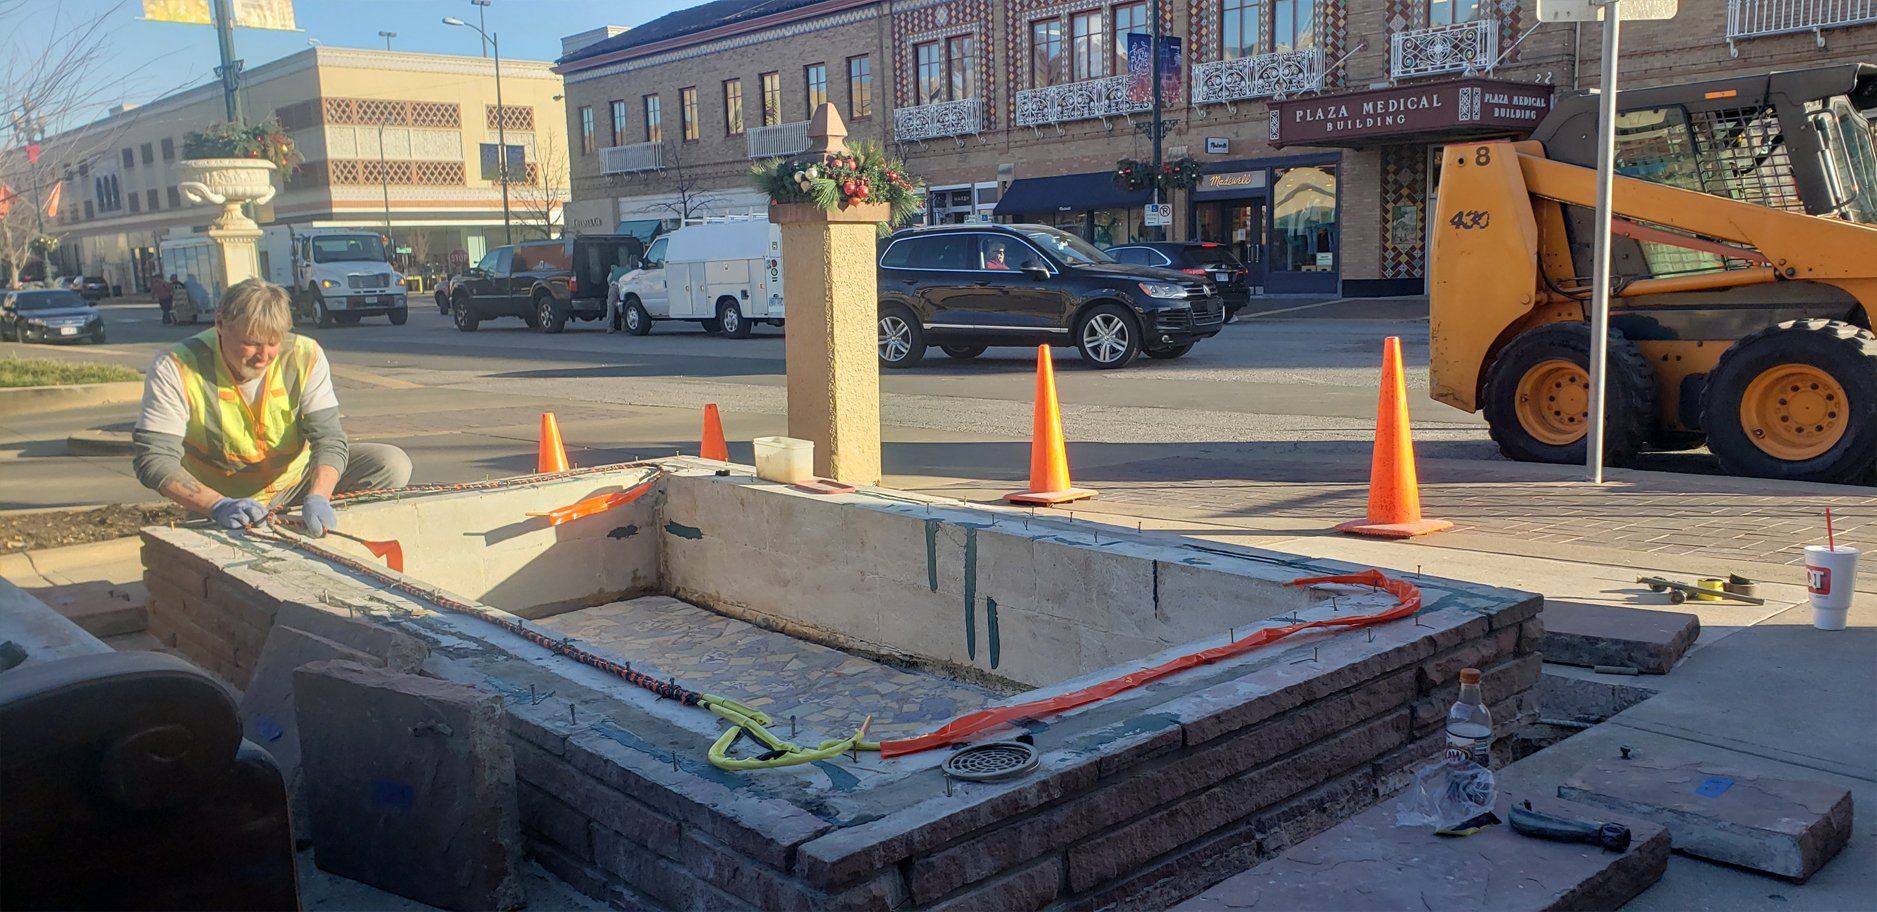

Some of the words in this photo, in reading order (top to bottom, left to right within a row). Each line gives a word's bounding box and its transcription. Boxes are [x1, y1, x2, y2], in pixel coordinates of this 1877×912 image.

[1296, 105, 1348, 122] PLAZA
[1363, 94, 1442, 115] MEDICAL
[1485, 93, 1509, 104] PLAZA
[1512, 96, 1546, 107] MEDICAL
[1494, 108, 1537, 119] BUILDING
[1326, 115, 1406, 132] BUILDING
[1475, 146, 1491, 167] 8
[1209, 173, 1252, 188] Madewell
[1449, 210, 1489, 230] 430
